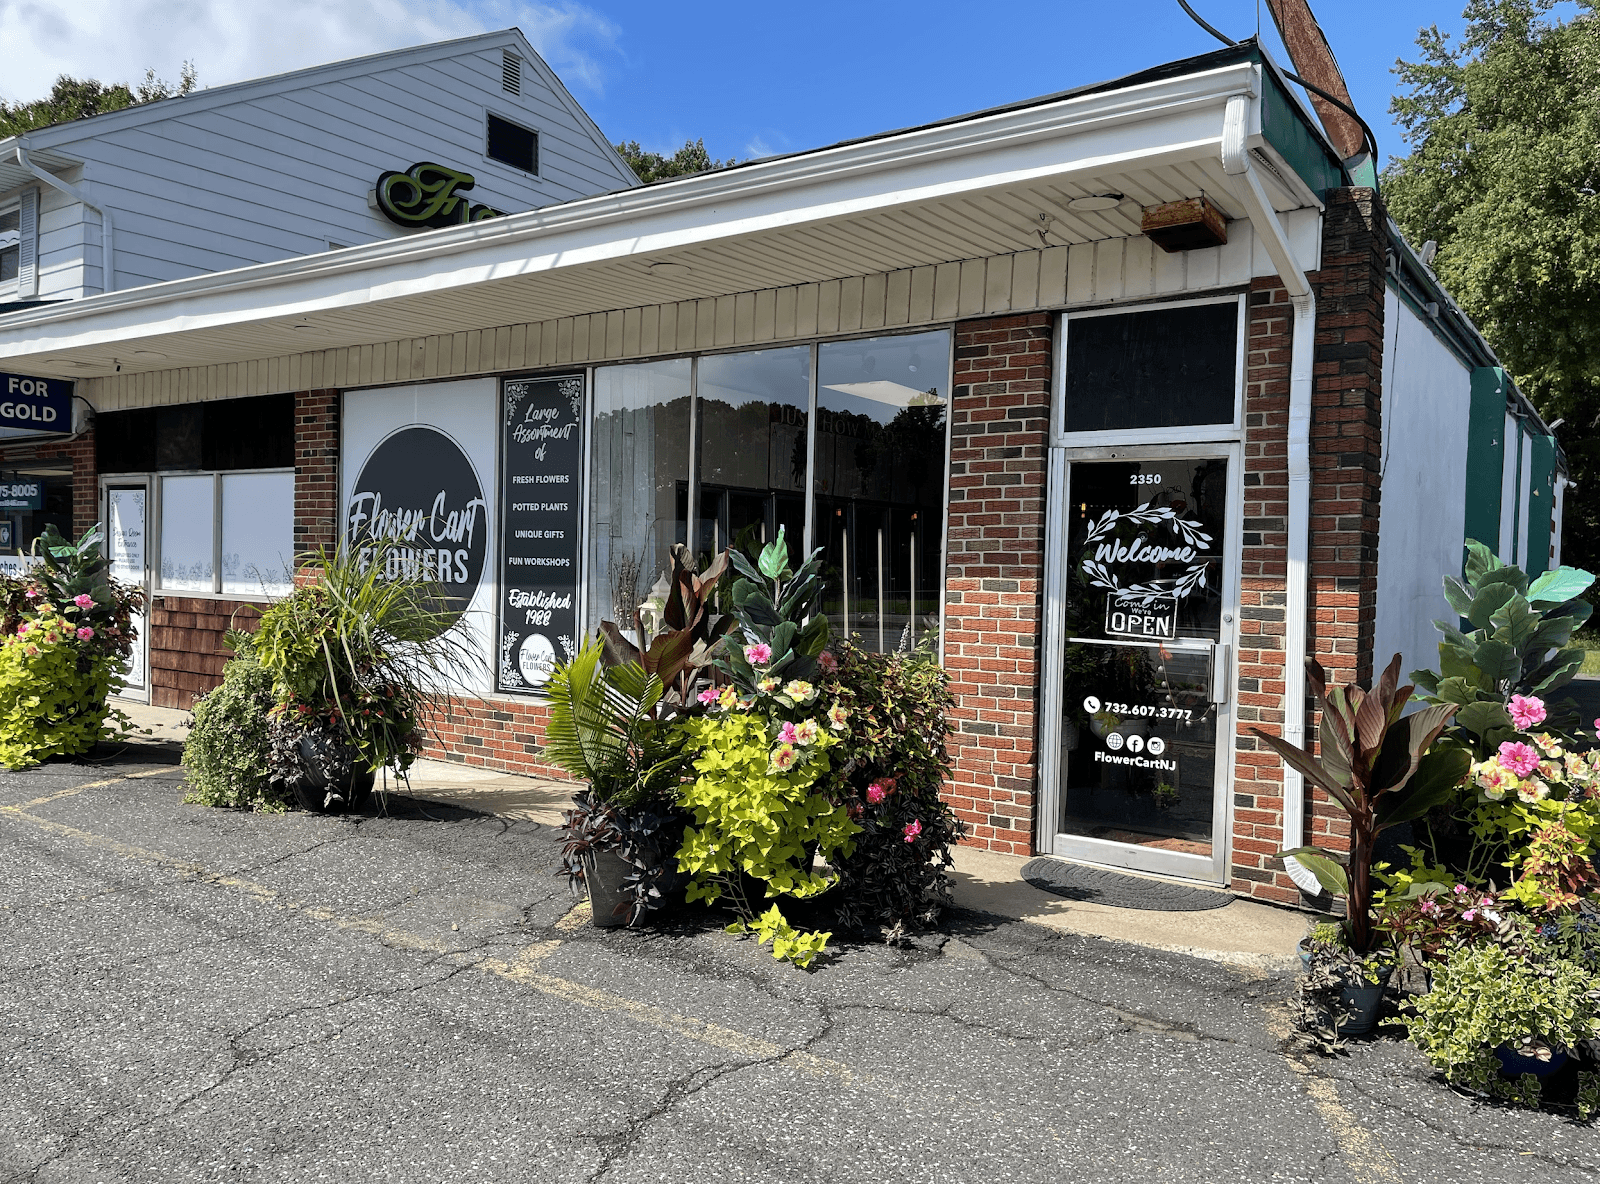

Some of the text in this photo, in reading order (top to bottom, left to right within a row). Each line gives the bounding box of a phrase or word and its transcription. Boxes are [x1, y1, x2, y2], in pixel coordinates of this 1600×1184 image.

[9, 377, 49, 398] FOR
[0, 402, 57, 423] GOLD
[524, 403, 559, 424] Large
[513, 423, 577, 443] Assortment
[534, 442, 547, 462] of
[512, 474, 569, 484] FRESH FLOWERS
[1129, 474, 1162, 486] 2350
[512, 502, 568, 512] POTTED PLANTS
[348, 489, 487, 550] Flower Cart
[515, 529, 564, 539] UNIQUE GIFTS
[1095, 537, 1196, 564] Welcome
[360, 547, 469, 584] FLOWERS
[508, 556, 570, 567] FUN WORKSHOPS
[508, 588, 571, 610] Established
[1114, 597, 1171, 612] Come in
[525, 610, 551, 627] 1988
[1131, 607, 1153, 616] We're
[1111, 611, 1171, 637] OPEN
[520, 648, 540, 662] Flower
[522, 661, 551, 672] FLOWERS
[1104, 702, 1193, 720] 732.607.3777
[1094, 751, 1177, 771] FlowerCartNJ
